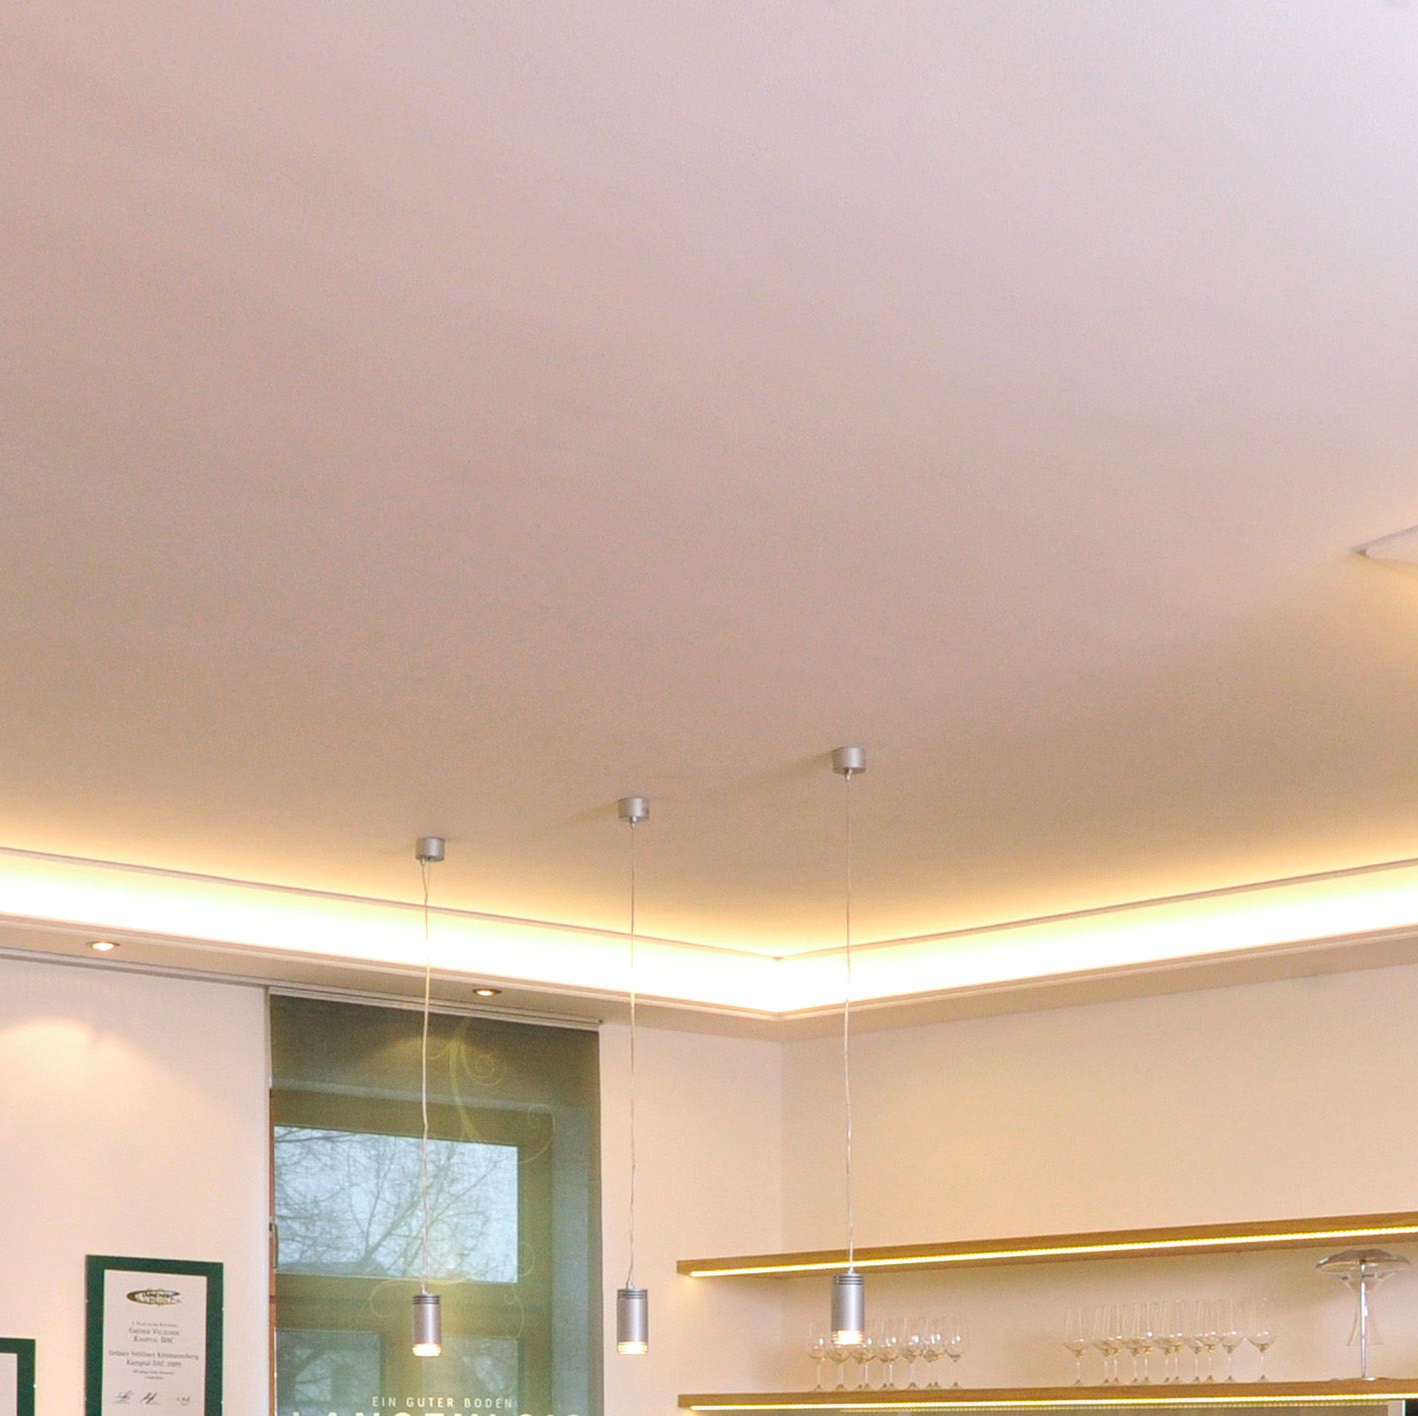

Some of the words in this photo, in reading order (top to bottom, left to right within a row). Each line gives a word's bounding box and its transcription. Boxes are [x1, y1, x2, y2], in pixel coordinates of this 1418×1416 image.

[372, 1396, 397, 1408] EIN
[406, 1397, 454, 1409] GUTER
[464, 1398, 513, 1410] BODEN
